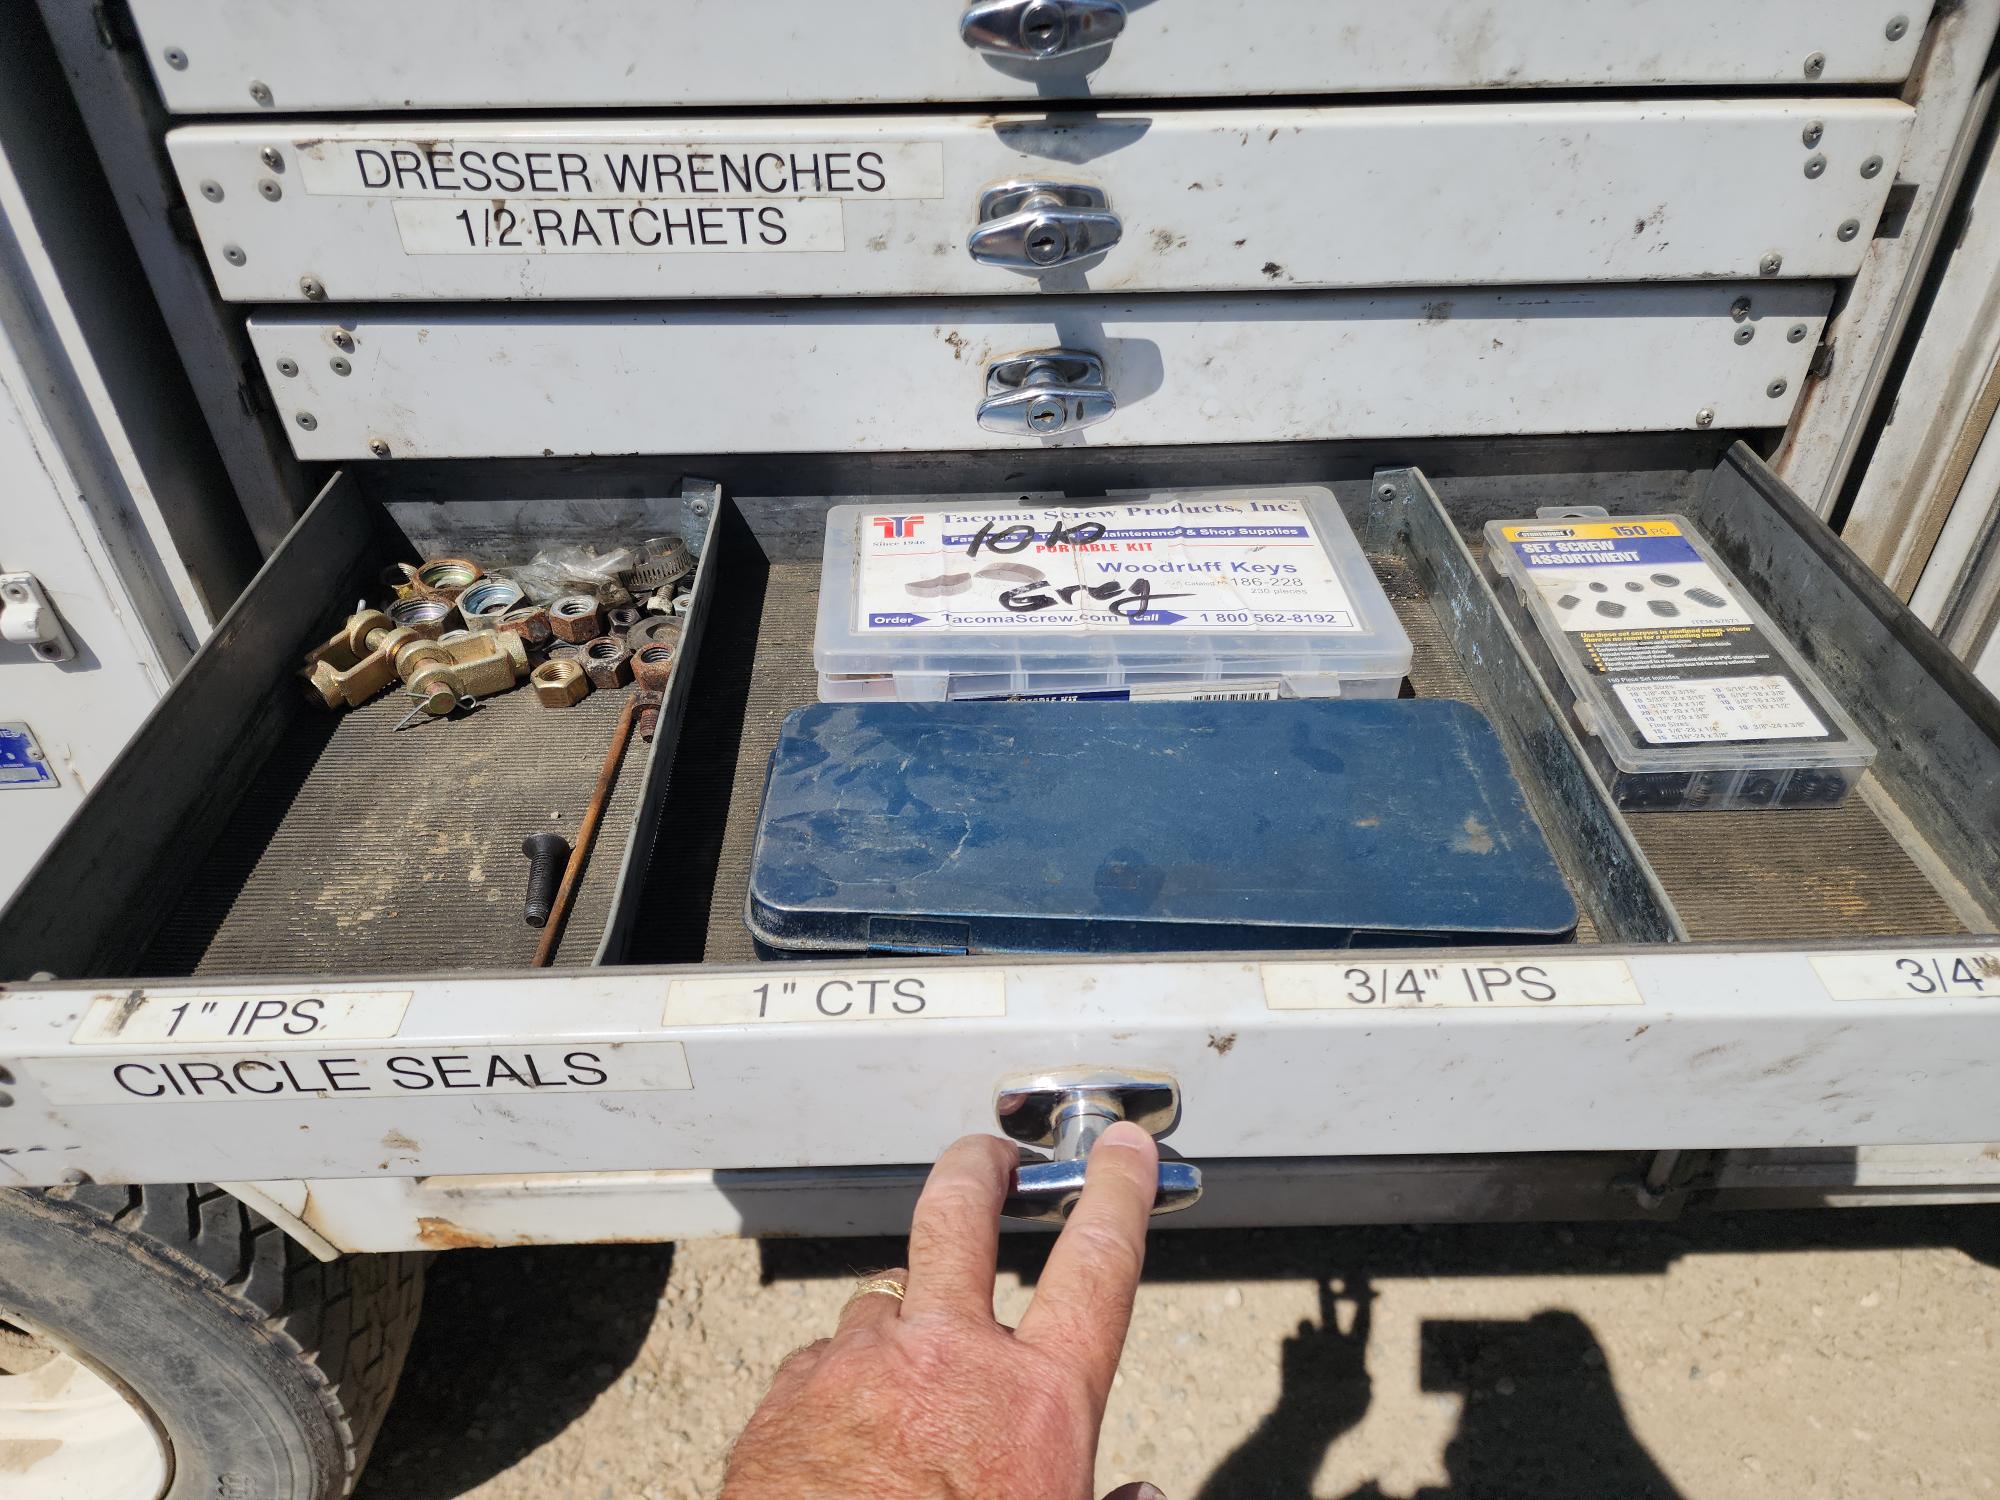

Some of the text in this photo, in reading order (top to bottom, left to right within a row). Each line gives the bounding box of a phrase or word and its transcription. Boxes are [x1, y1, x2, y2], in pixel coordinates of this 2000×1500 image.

[356, 150, 887, 193] DRESSER WRENCHES
[455, 206, 788, 247] 1/2 RATCHETS
[944, 502, 1298, 524] Tacoma Screw Products, Inc.
[1101, 528, 1183, 539] Maintenance
[1200, 527, 1235, 538] Shop
[1238, 527, 1298, 538] Supplies
[1610, 525, 1648, 536] 150
[1036, 542, 1153, 554] PORTABLE KIT
[1521, 540, 1615, 554] SET SCREW
[1531, 551, 1640, 565] ASSORTMENT
[1097, 561, 1298, 575] Woodruff Keys
[1231, 577, 1303, 587] 186-228
[1273, 588, 1308, 596] pieces
[874, 615, 914, 625] Order
[942, 612, 1118, 624] TacomaScrew.com
[1133, 613, 1160, 622] Call
[1200, 613, 1337, 624] 1 800 562-8192
[1895, 957, 1990, 994] 3/4"
[1346, 967, 1557, 1005] 3/4" IPS
[754, 978, 927, 1017] 1" CTS
[167, 999, 325, 1037] 1" IPS
[113, 1052, 607, 1099] CIRCLE SEALS
